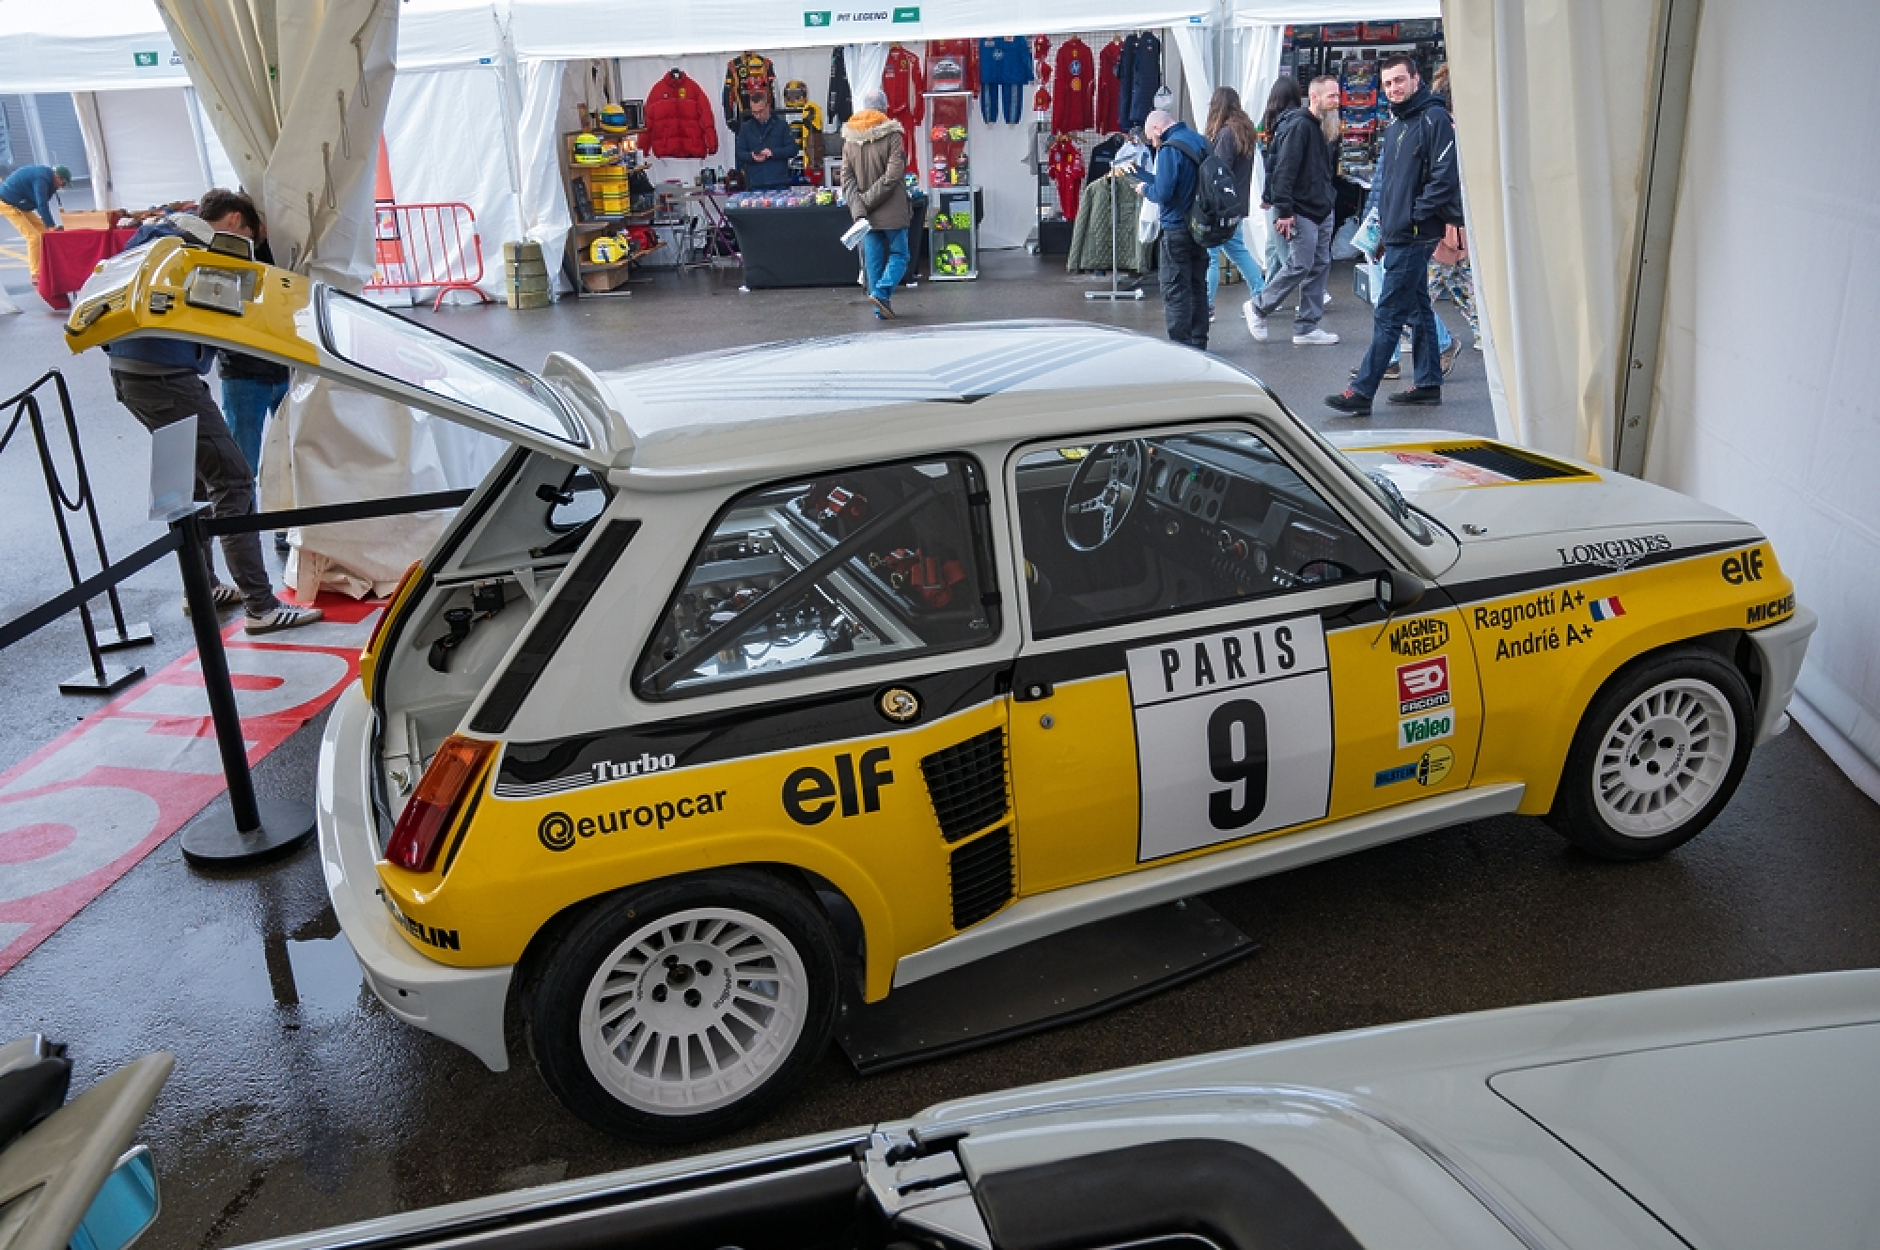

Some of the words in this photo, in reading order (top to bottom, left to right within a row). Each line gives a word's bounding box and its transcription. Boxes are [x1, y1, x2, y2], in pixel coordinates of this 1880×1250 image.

[836, 12, 852, 21] PIT
[853, 11, 889, 21] LEGEND
[1556, 533, 1672, 566] LONGINES
[1721, 549, 1763, 585] elf
[1474, 592, 1556, 631] Ragnotti
[1560, 589, 1585, 613] A+
[1159, 625, 1297, 693] PARIS
[1494, 627, 1560, 662] Andrié
[1566, 623, 1594, 647] A+
[1402, 716, 1451, 744] Valeo
[591, 752, 676, 783] Turbo
[1207, 698, 1268, 831] 9
[781, 746, 894, 826] elf
